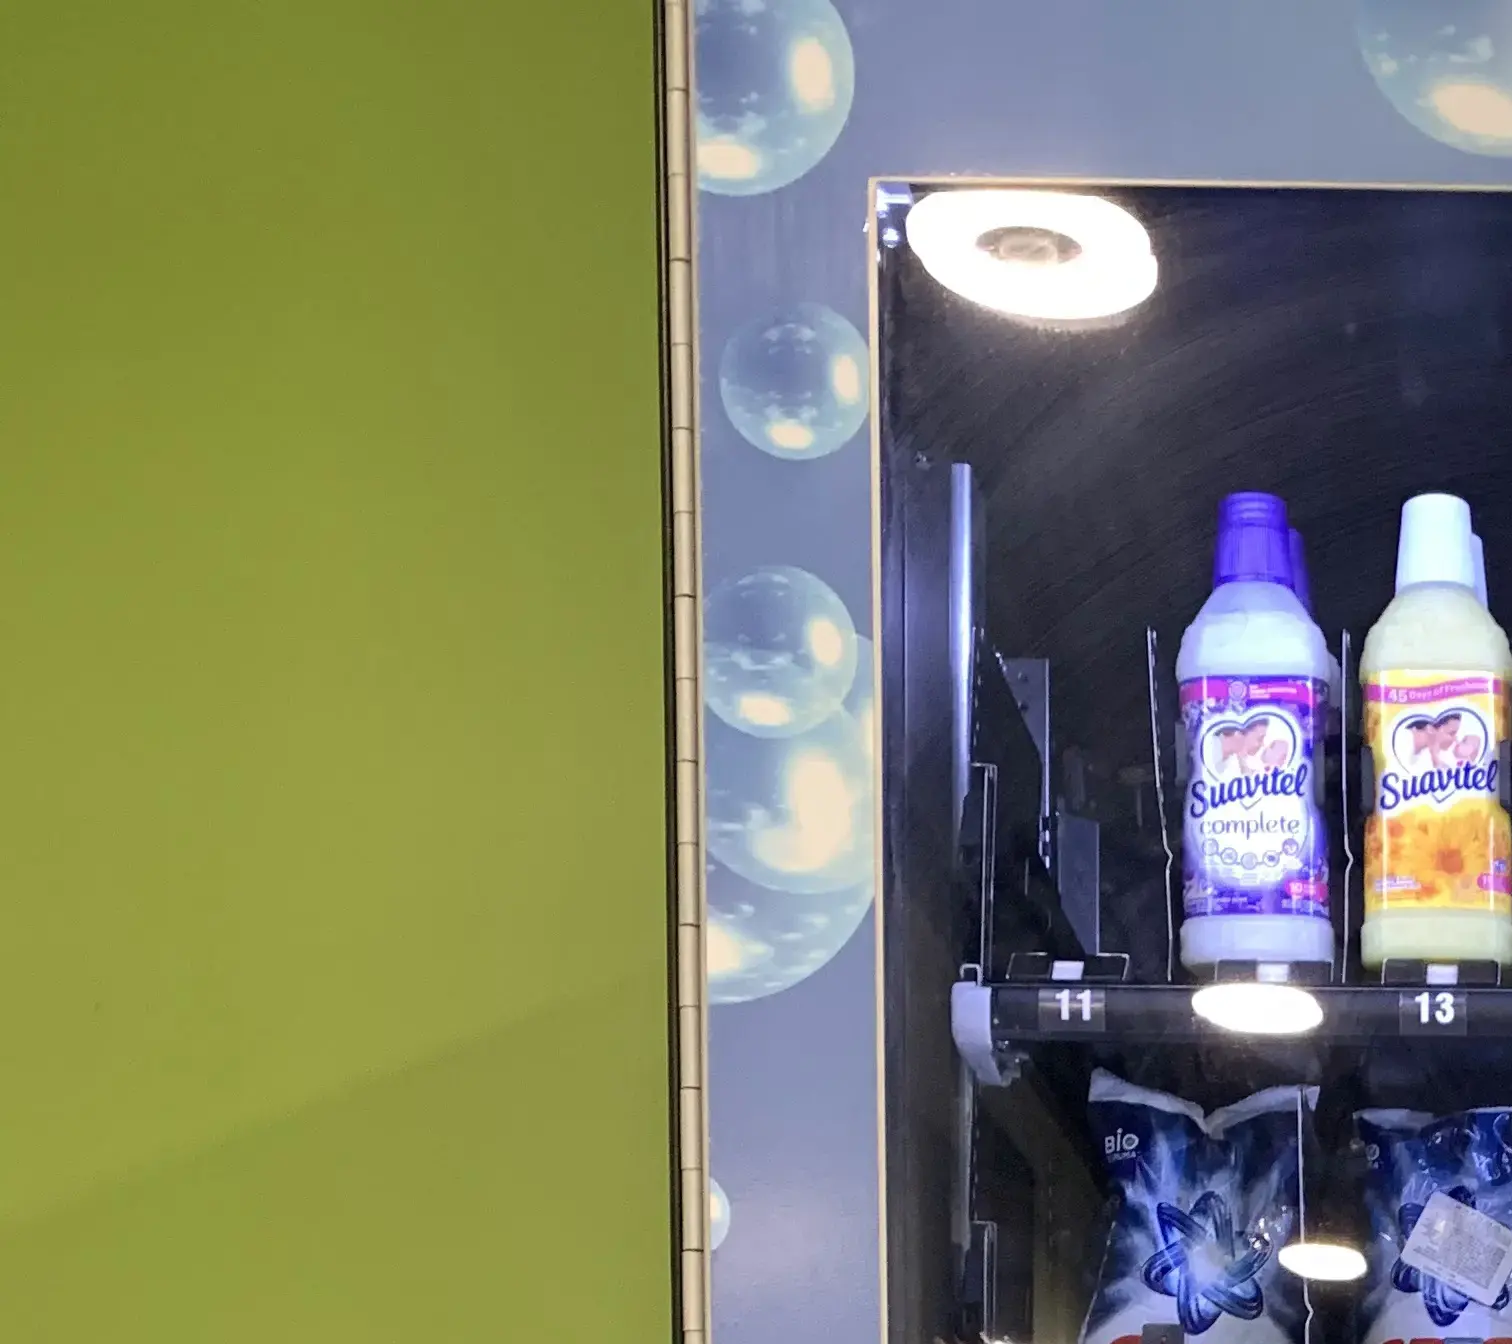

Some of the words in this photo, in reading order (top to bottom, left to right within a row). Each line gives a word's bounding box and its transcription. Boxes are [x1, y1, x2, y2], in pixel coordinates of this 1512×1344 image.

[1190, 763, 1308, 819] Suavitel
[1380, 760, 1498, 810] Suavitel
[1200, 811, 1301, 840] complete
[1055, 989, 1092, 1021] 11
[1415, 992, 1455, 1024] 13
